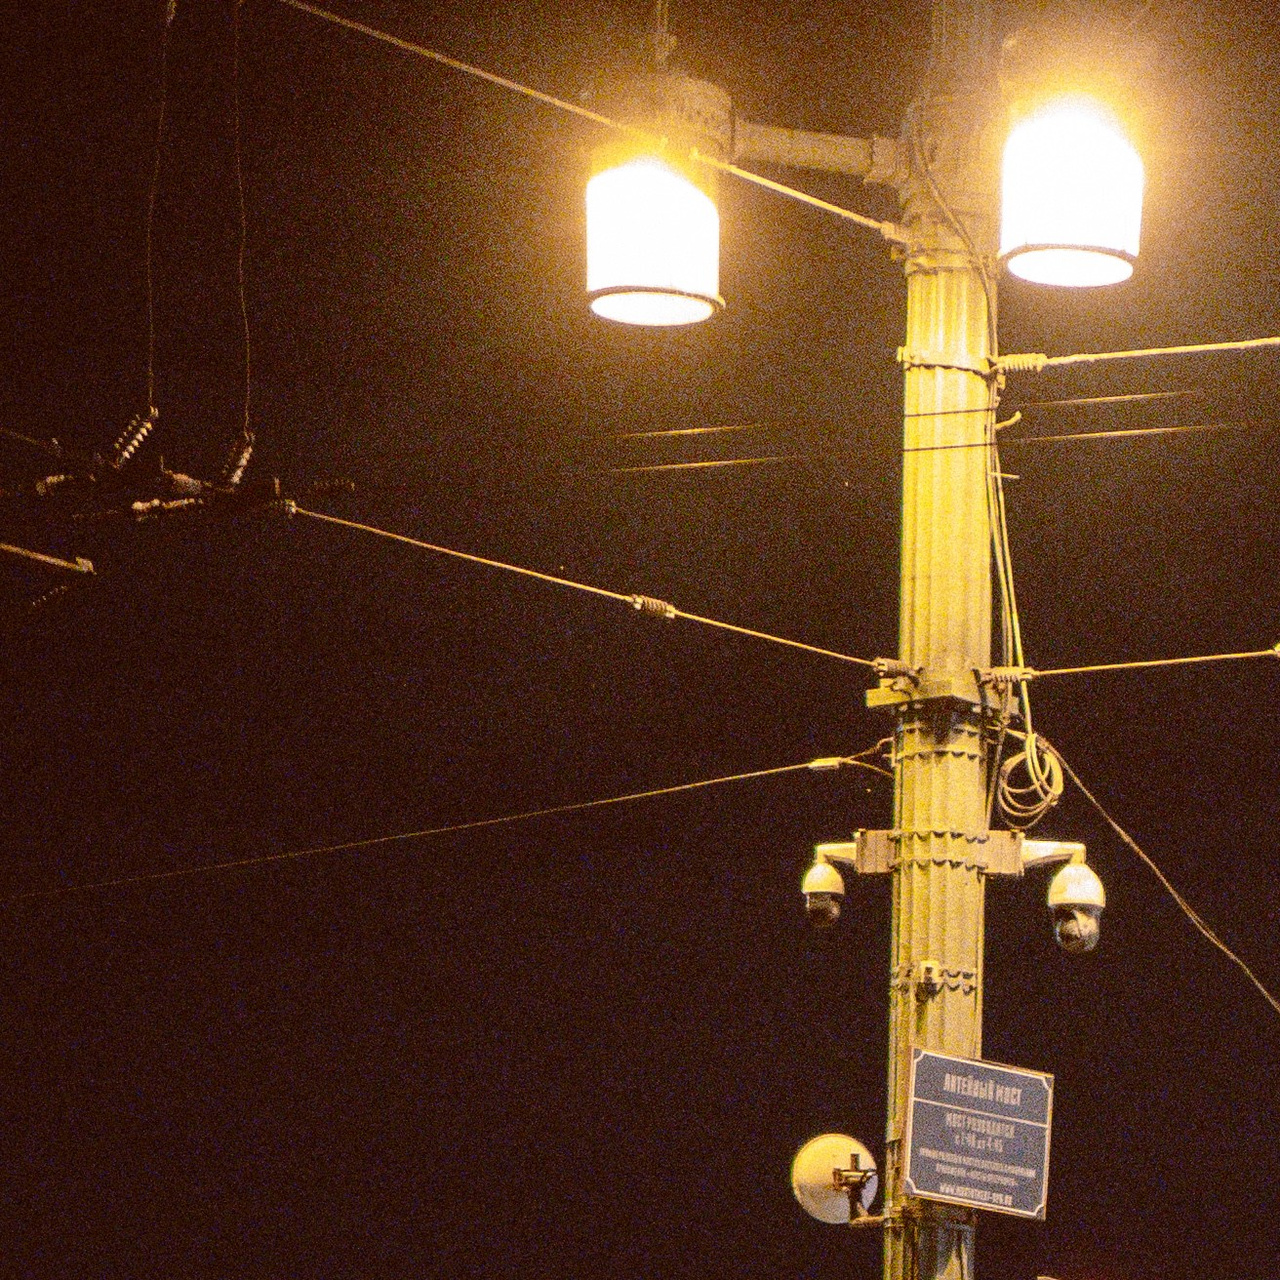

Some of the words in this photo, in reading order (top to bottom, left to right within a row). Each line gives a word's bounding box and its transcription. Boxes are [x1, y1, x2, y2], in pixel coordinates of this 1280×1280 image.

[943, 1073, 995, 1100] ЛИТЕЙНЫЙ
[996, 1084, 1022, 1106] МОСТ
[946, 1112, 966, 1128] МОСТ
